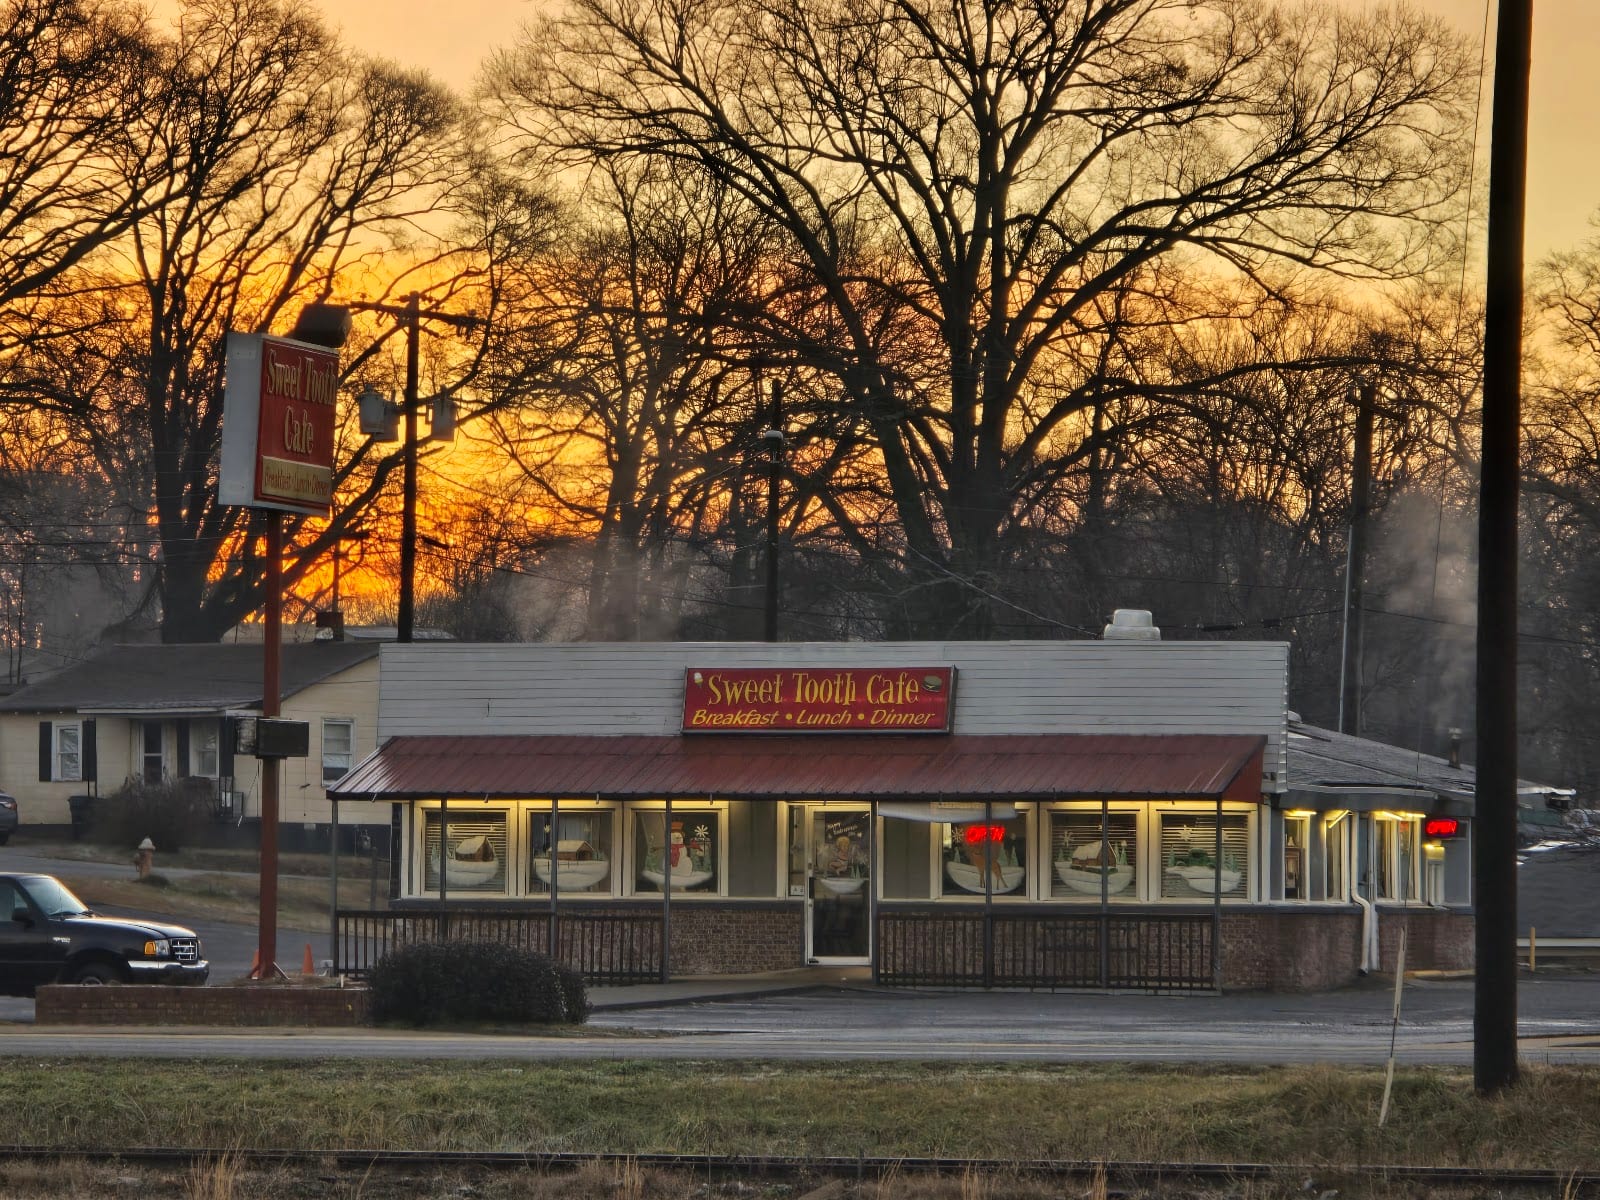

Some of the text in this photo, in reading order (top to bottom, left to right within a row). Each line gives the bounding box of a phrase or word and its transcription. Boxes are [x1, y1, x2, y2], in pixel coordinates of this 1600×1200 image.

[267, 350, 336, 404] Sweet Tooth
[284, 406, 314, 454] Cafe
[708, 671, 919, 706] Sweet Tooth Cafe
[692, 709, 935, 726] Breakfast Lunch Dinner
